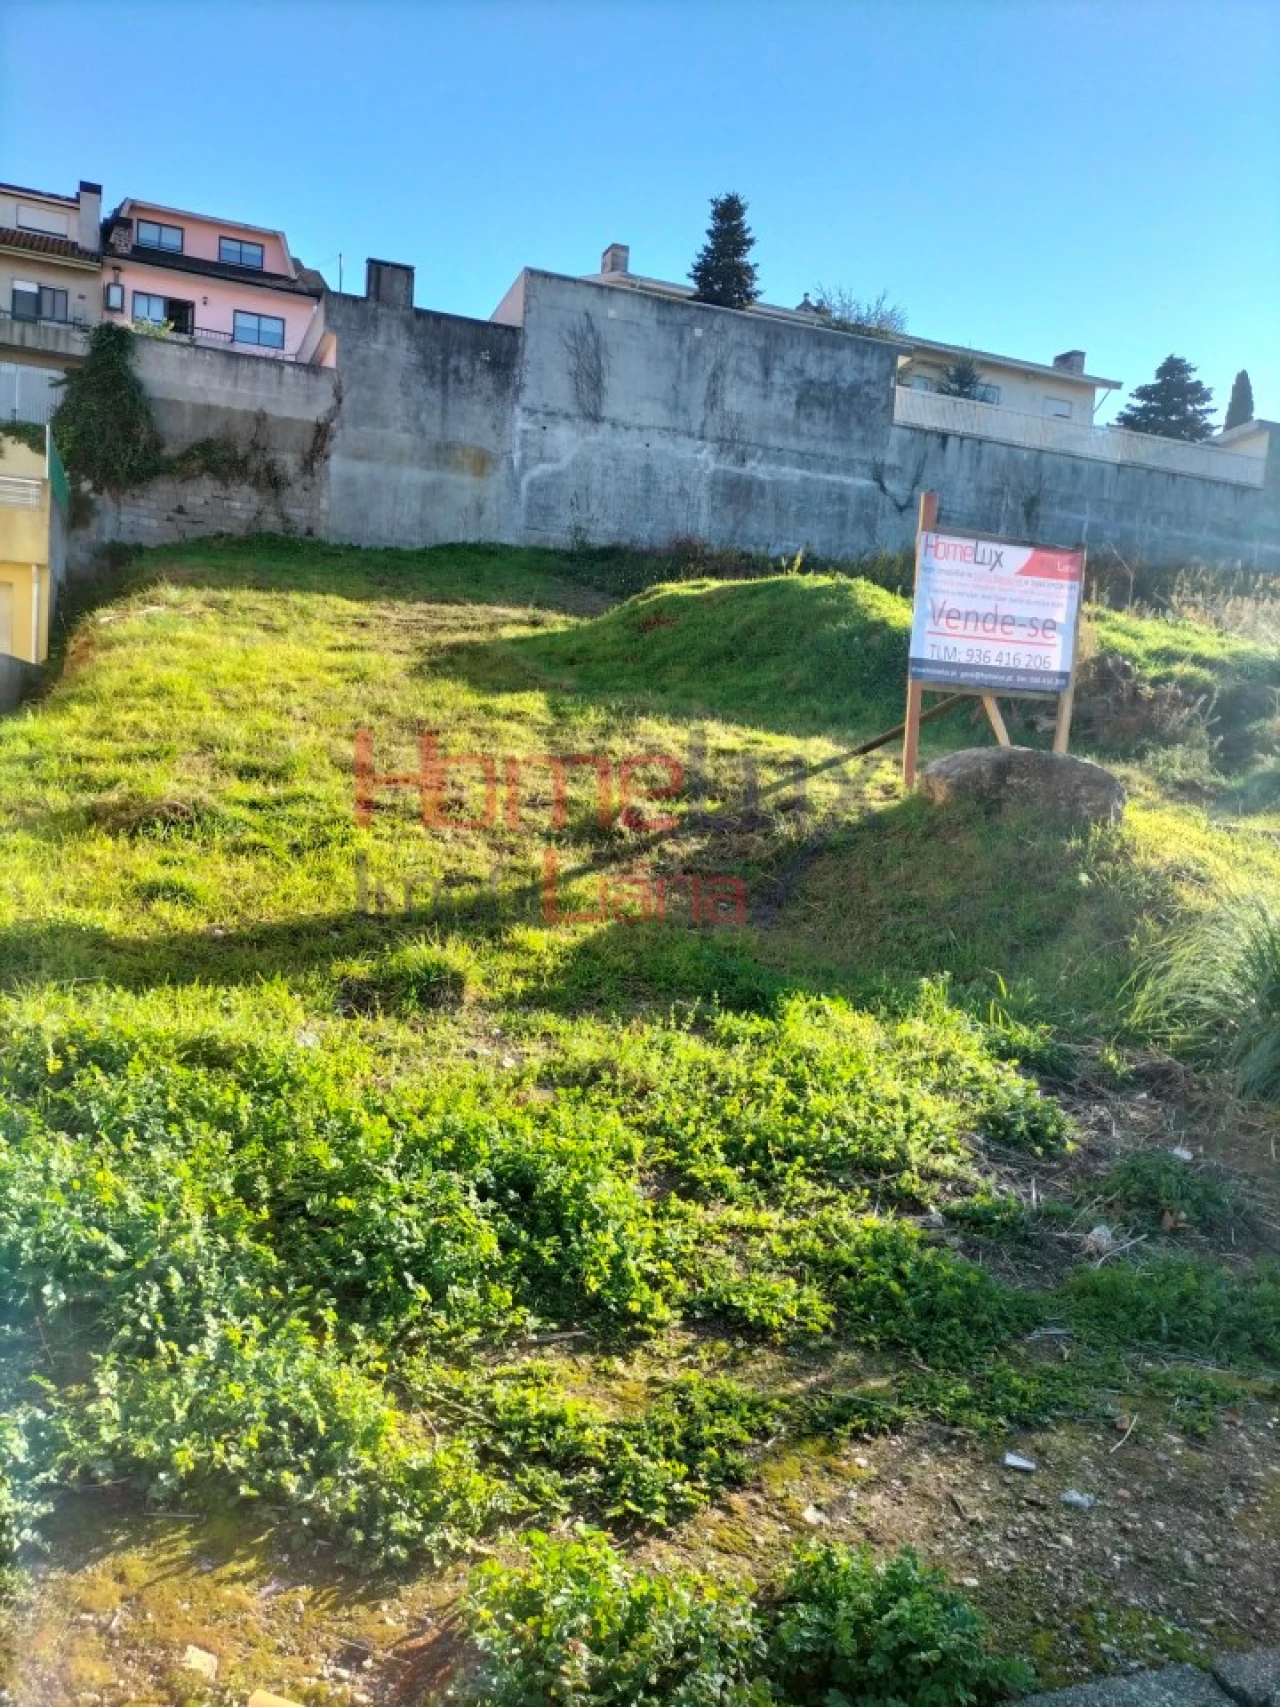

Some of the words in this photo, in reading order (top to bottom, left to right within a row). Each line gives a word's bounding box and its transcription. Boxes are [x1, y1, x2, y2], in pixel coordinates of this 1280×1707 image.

[924, 532, 1004, 571] HomeLux
[930, 597, 1057, 639] Vende-se
[966, 648, 991, 664] 936
[995, 651, 1021, 667] 416
[1025, 654, 1052, 669] 206
